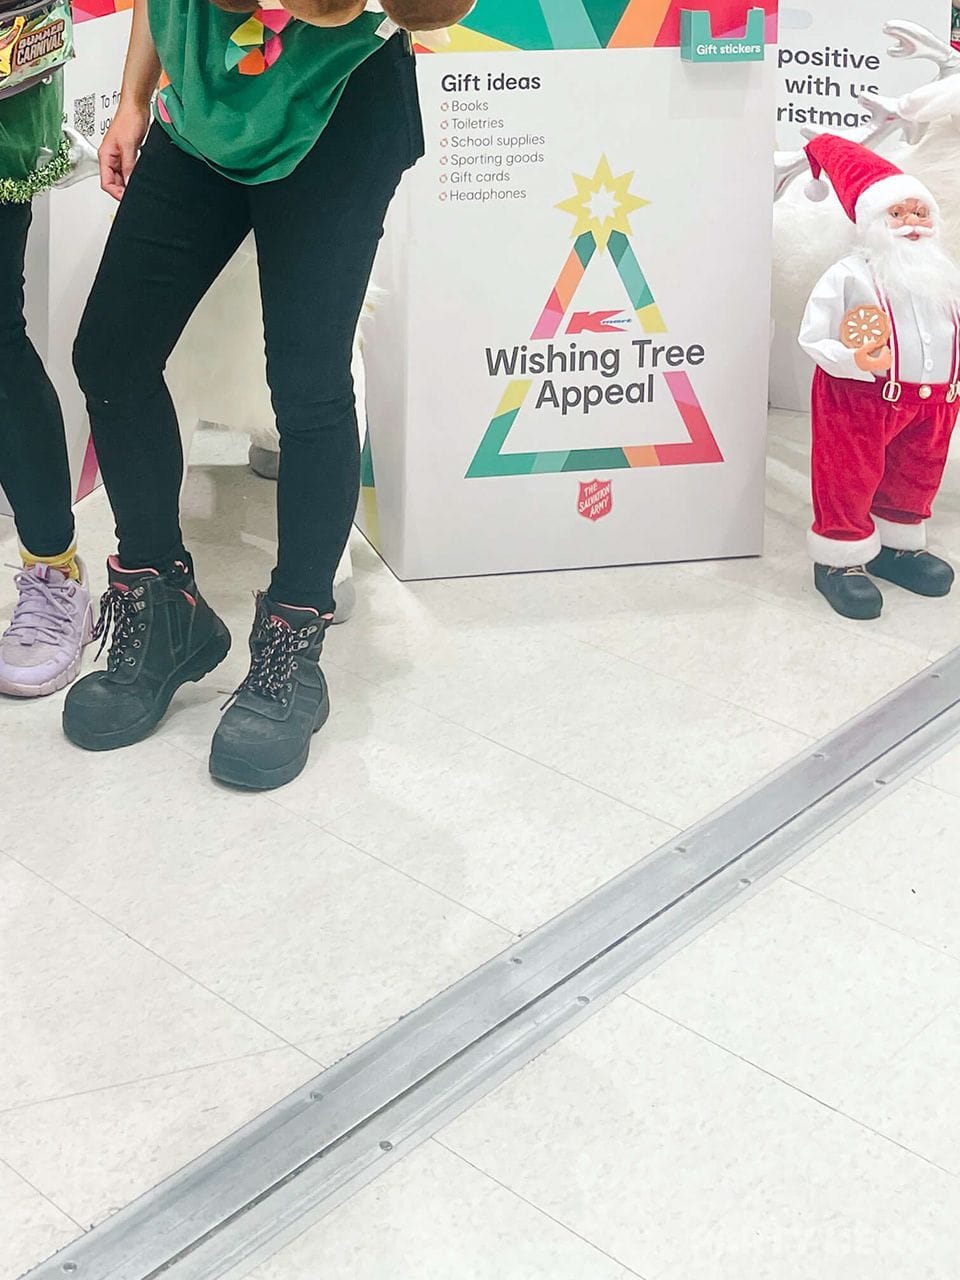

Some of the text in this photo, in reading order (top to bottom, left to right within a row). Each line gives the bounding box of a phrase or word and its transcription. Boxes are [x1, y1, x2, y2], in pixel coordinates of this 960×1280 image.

[16, 32, 64, 65] CARNIVAL
[696, 43, 762, 55] Gift stickers
[777, 46, 881, 71] positive
[441, 72, 541, 92] Gift ideas
[785, 74, 841, 98] with
[100, 94, 111, 109] To
[451, 100, 489, 112] Books
[451, 118, 505, 130] Toiletries
[777, 102, 872, 128] ristmas
[450, 134, 546, 149] School supplies
[450, 152, 545, 168] Sporting goods
[450, 170, 511, 184] Gift cards
[450, 188, 528, 202] Headphones
[485, 340, 705, 378] Wishing Tree
[535, 373, 655, 416] Appeal
[579, 483, 610, 513] SALVATION
[584, 482, 598, 497] THE
[590, 496, 609, 518] ARMY
